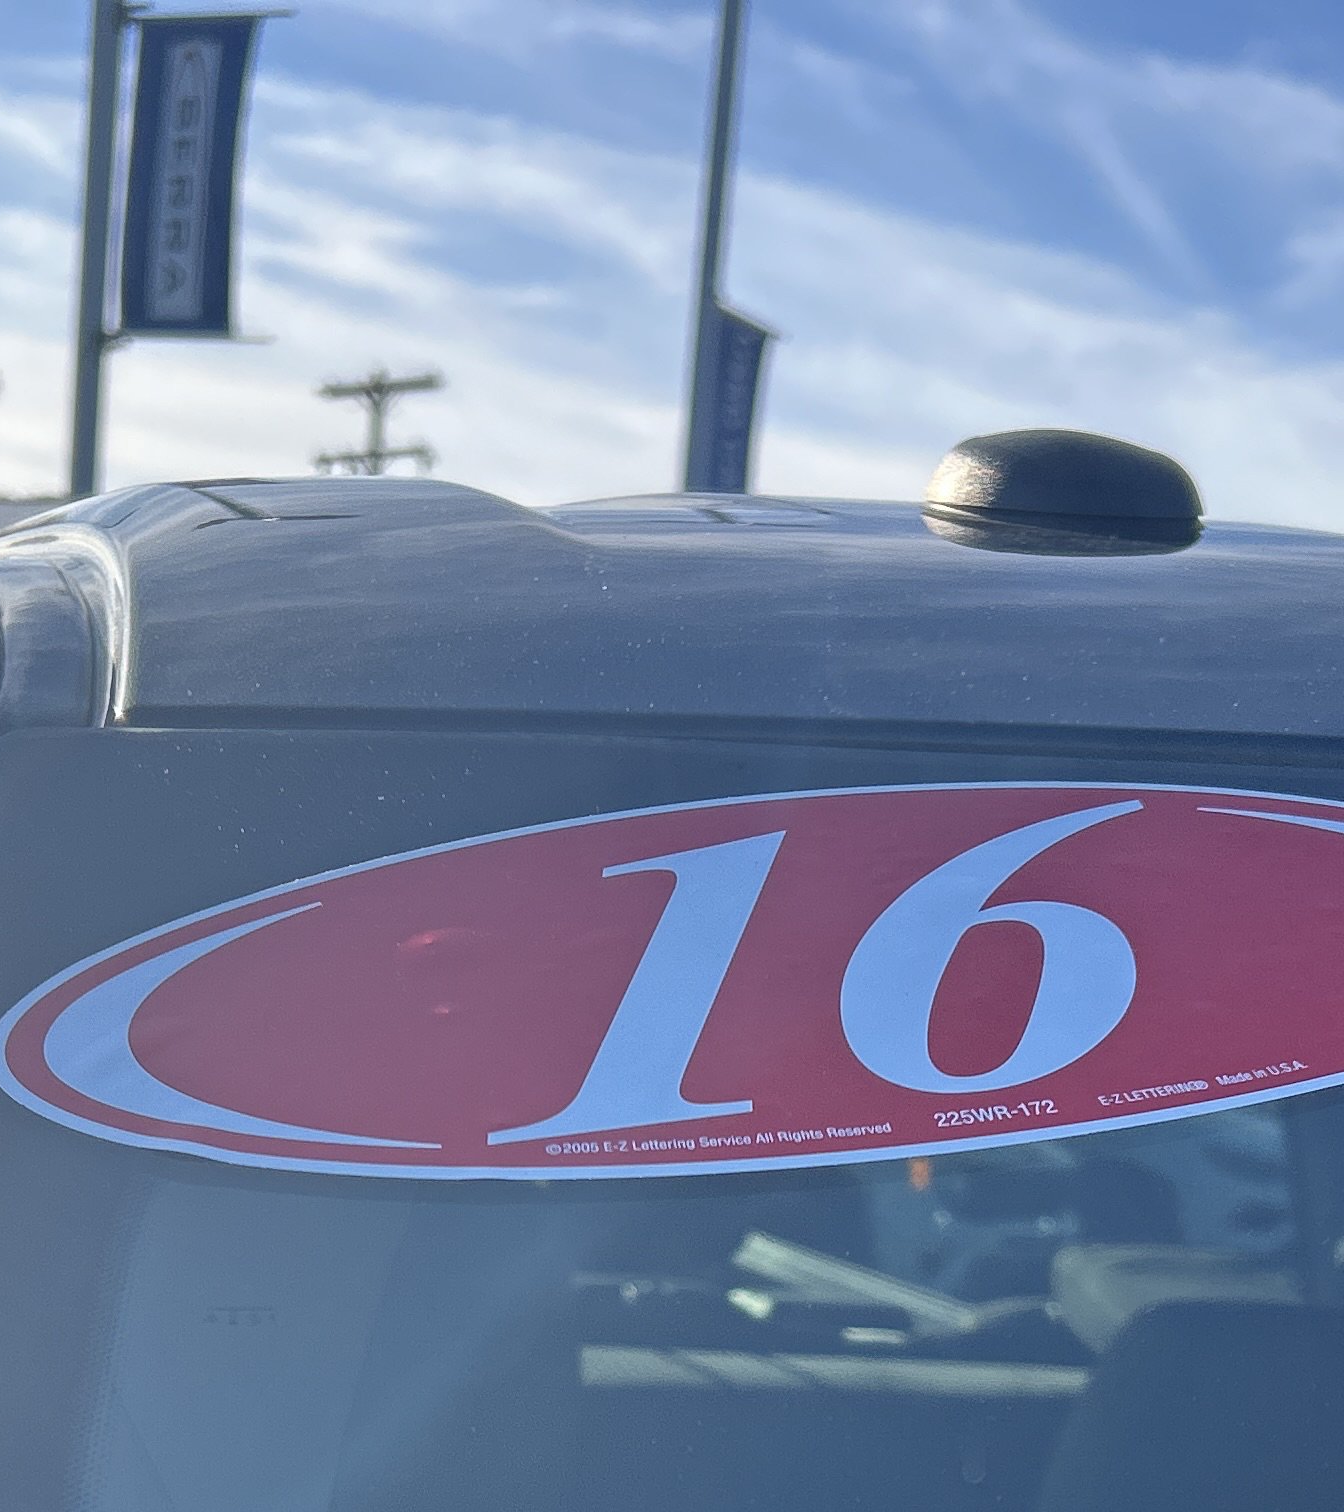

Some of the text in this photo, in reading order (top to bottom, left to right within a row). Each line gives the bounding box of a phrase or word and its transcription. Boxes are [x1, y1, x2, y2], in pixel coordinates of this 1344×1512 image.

[487, 800, 1144, 1145] 16
[1215, 1072, 1253, 1087] Made
[1253, 1069, 1267, 1080] in
[933, 1099, 1059, 1128] 225WR-172
[1097, 1093, 1124, 1107] E-Z
[603, 1140, 629, 1153] E-Z
[632, 1137, 696, 1152] Lettering
[699, 1134, 751, 1148] Service
[755, 1131, 775, 1144] All
[776, 1128, 824, 1143] Rights
[826, 1122, 893, 1139] Reserved
